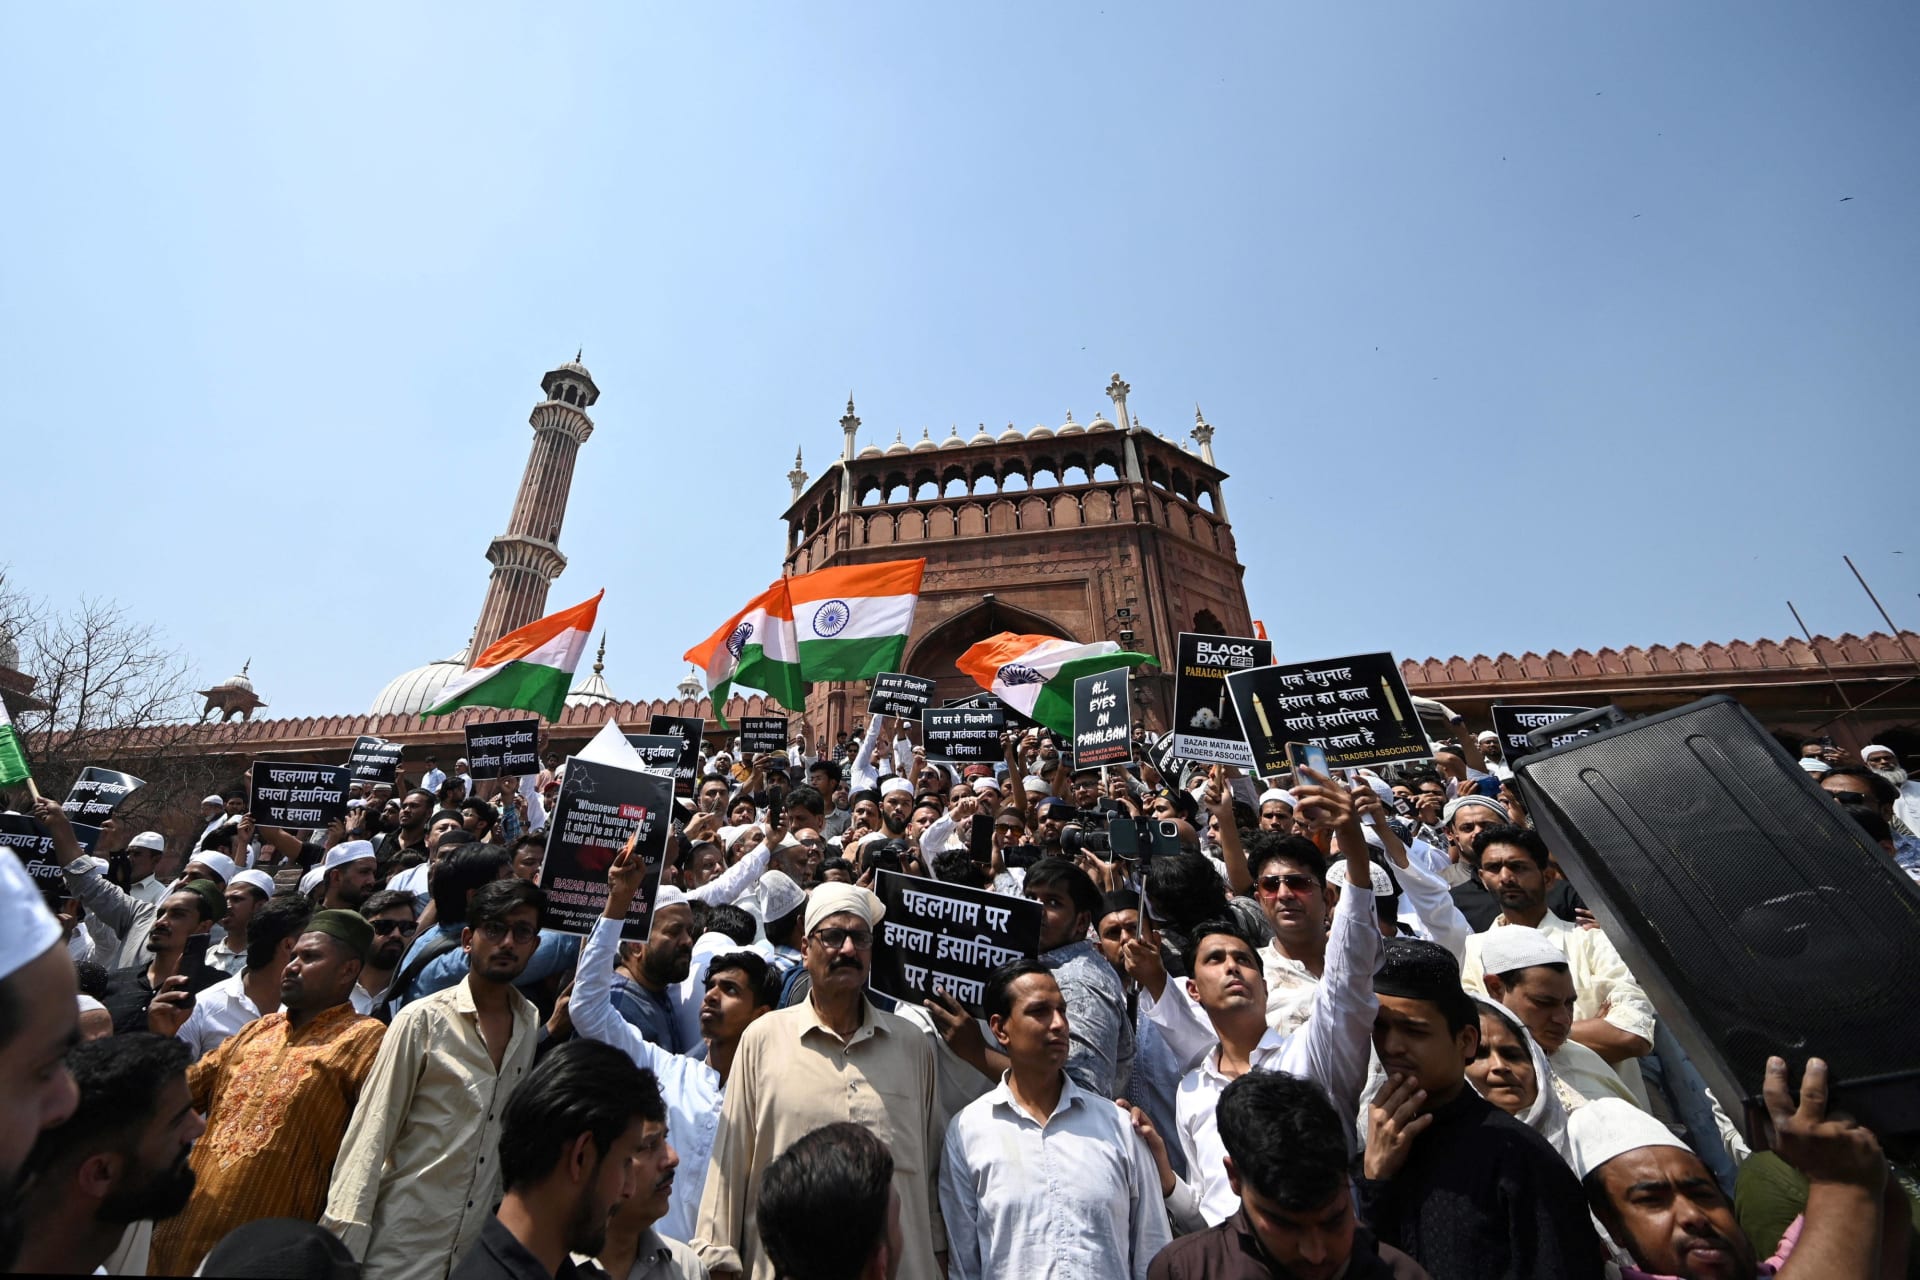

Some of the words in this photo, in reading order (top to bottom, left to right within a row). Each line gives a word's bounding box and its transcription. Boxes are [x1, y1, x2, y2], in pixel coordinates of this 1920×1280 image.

[1197, 641, 1254, 657] BLACK
[1196, 653, 1230, 666] DAY
[1185, 666, 1229, 679] PAHALGAM
[1280, 673, 1303, 690] एक
[1305, 667, 1352, 687] बेगुनाह
[1091, 680, 1109, 696] ALL
[1089, 694, 1116, 713] EYES
[1278, 693, 1315, 712] इंसान
[1316, 690, 1335, 705] का
[1338, 687, 1370, 702] कत्ल
[932, 716, 941, 725] हर
[942, 716, 953, 725] घर
[954, 714, 961, 724] से
[964, 713, 993, 725] निकलेगी
[1096, 711, 1110, 727] ON
[1283, 712, 1315, 731] सारी
[1316, 708, 1380, 731] इंसानियत
[668, 724, 684, 736] ALL
[987, 730, 998, 740] का
[1077, 724, 1128, 747] PAHALGAM
[1329, 731, 1362, 749] कत्ल
[1361, 726, 1376, 746] है
[945, 744, 954, 756] हो
[1183, 737, 1208, 748] BAZAR
[1209, 741, 1231, 751] MATIA
[1232, 743, 1249, 753] MAH
[1098, 751, 1128, 761] ASSOCIATION
[1180, 746, 1214, 758] TRADERS
[1214, 750, 1253, 763] ASSOCIAT
[1340, 750, 1375, 763] TRADERS
[1375, 744, 1424, 758] ASSOCIATION
[269, 769, 319, 784] पहलगाम
[321, 772, 336, 785] पर
[258, 787, 289, 801] हमला
[289, 785, 342, 803] इंसानियत
[270, 806, 286, 819] पर
[286, 808, 322, 822] हमला!
[567, 809, 601, 824] innocent
[602, 814, 628, 828] human
[622, 806, 644, 819] killed
[646, 811, 656, 821] an
[565, 822, 571, 831] it
[573, 823, 592, 834] shall
[593, 825, 602, 835] be
[603, 828, 613, 837] as
[614, 829, 622, 838] if
[562, 832, 584, 845] killed
[585, 834, 595, 846] all
[596, 837, 626, 851] mankin
[553, 878, 585, 893] BAZAR
[585, 881, 610, 895] MATI
[548, 890, 588, 906] TRADERS
[550, 907, 575, 919] Strongly
[576, 910, 602, 920] condem
[902, 888, 981, 927] पहलगाम
[985, 905, 1012, 934] पर
[563, 919, 581, 928] attack
[884, 920, 934, 955] हमला
[904, 963, 928, 992] पर
[931, 970, 986, 1006] हमला
